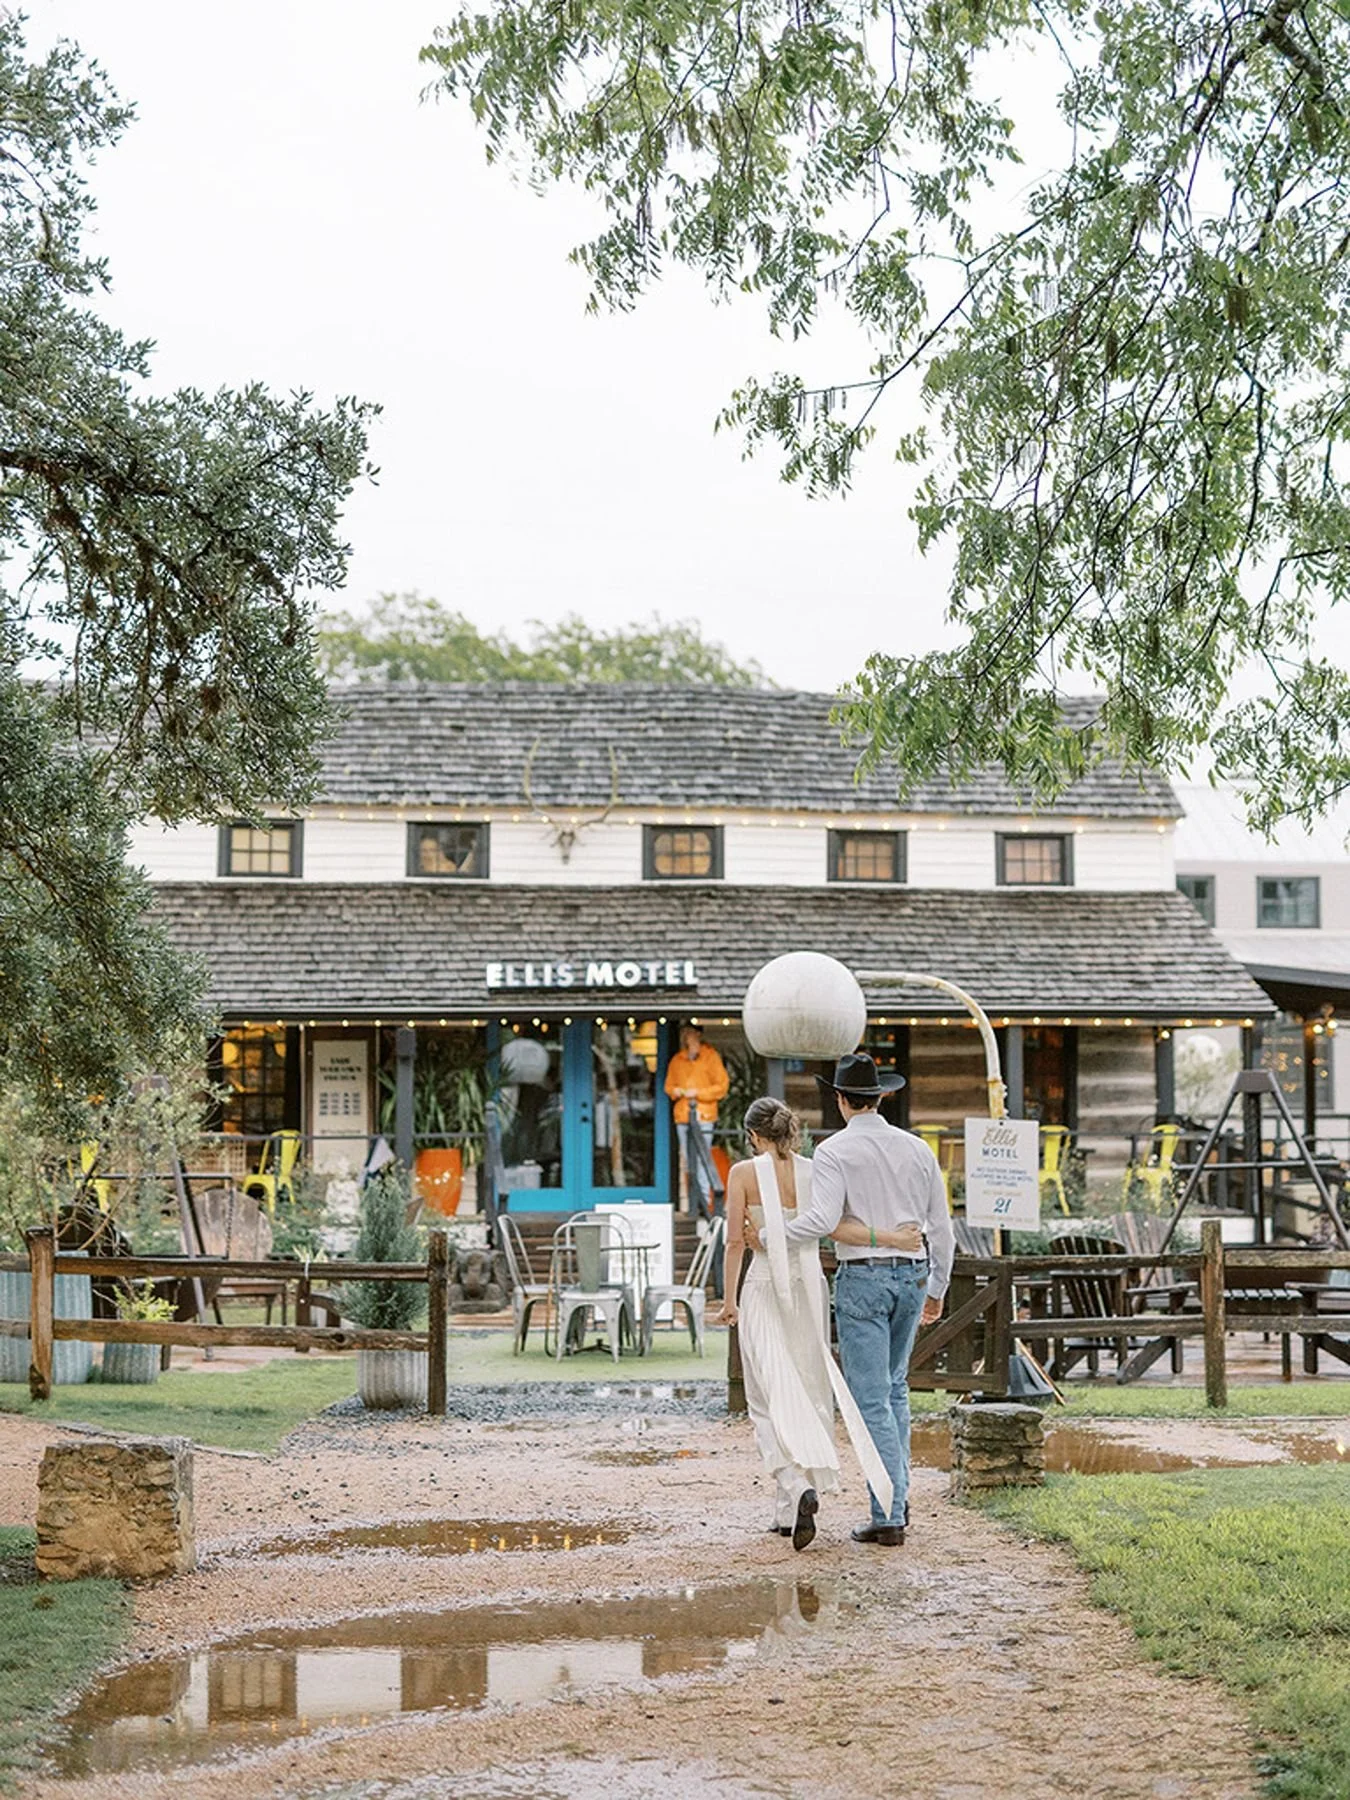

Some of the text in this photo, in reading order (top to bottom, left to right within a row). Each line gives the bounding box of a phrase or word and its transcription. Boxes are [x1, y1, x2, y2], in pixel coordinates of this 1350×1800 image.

[486, 961, 699, 987] ELLIS MOTEL
[983, 1127, 1017, 1146] Ellis
[982, 1148, 1018, 1158] MOTEL
[993, 1198, 1011, 1213] 21
